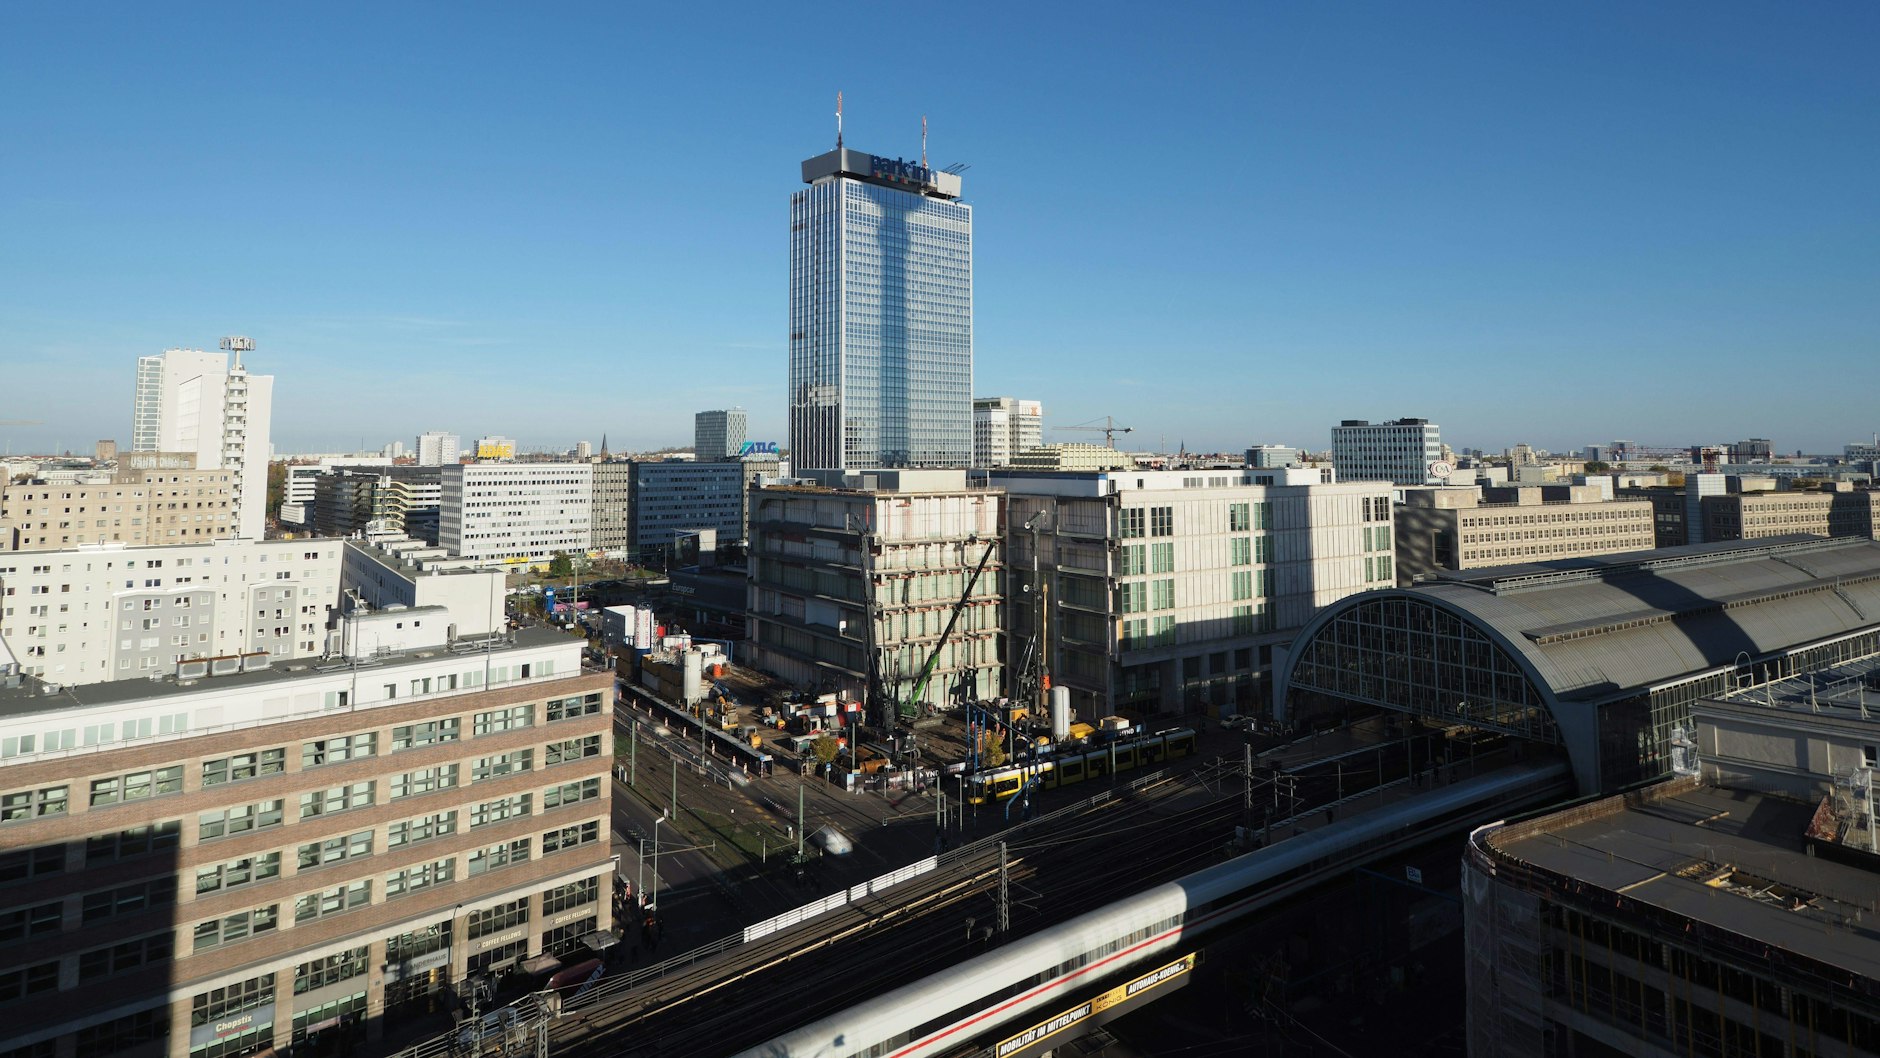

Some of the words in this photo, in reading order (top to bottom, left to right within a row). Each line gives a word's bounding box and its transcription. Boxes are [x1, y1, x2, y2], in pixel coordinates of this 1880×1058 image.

[555, 913, 571, 924] COFFEE
[571, 907, 592, 920] FELLOWS
[482, 936, 500, 948] COFFEE
[500, 930, 522, 942] FELLOWS
[215, 1014, 252, 1032] Chopstix
[1000, 1029, 1037, 1056] MOBILITÄT
[1036, 1025, 1046, 1038] IM
[1046, 1004, 1091, 1033] MITTELPUNKT
